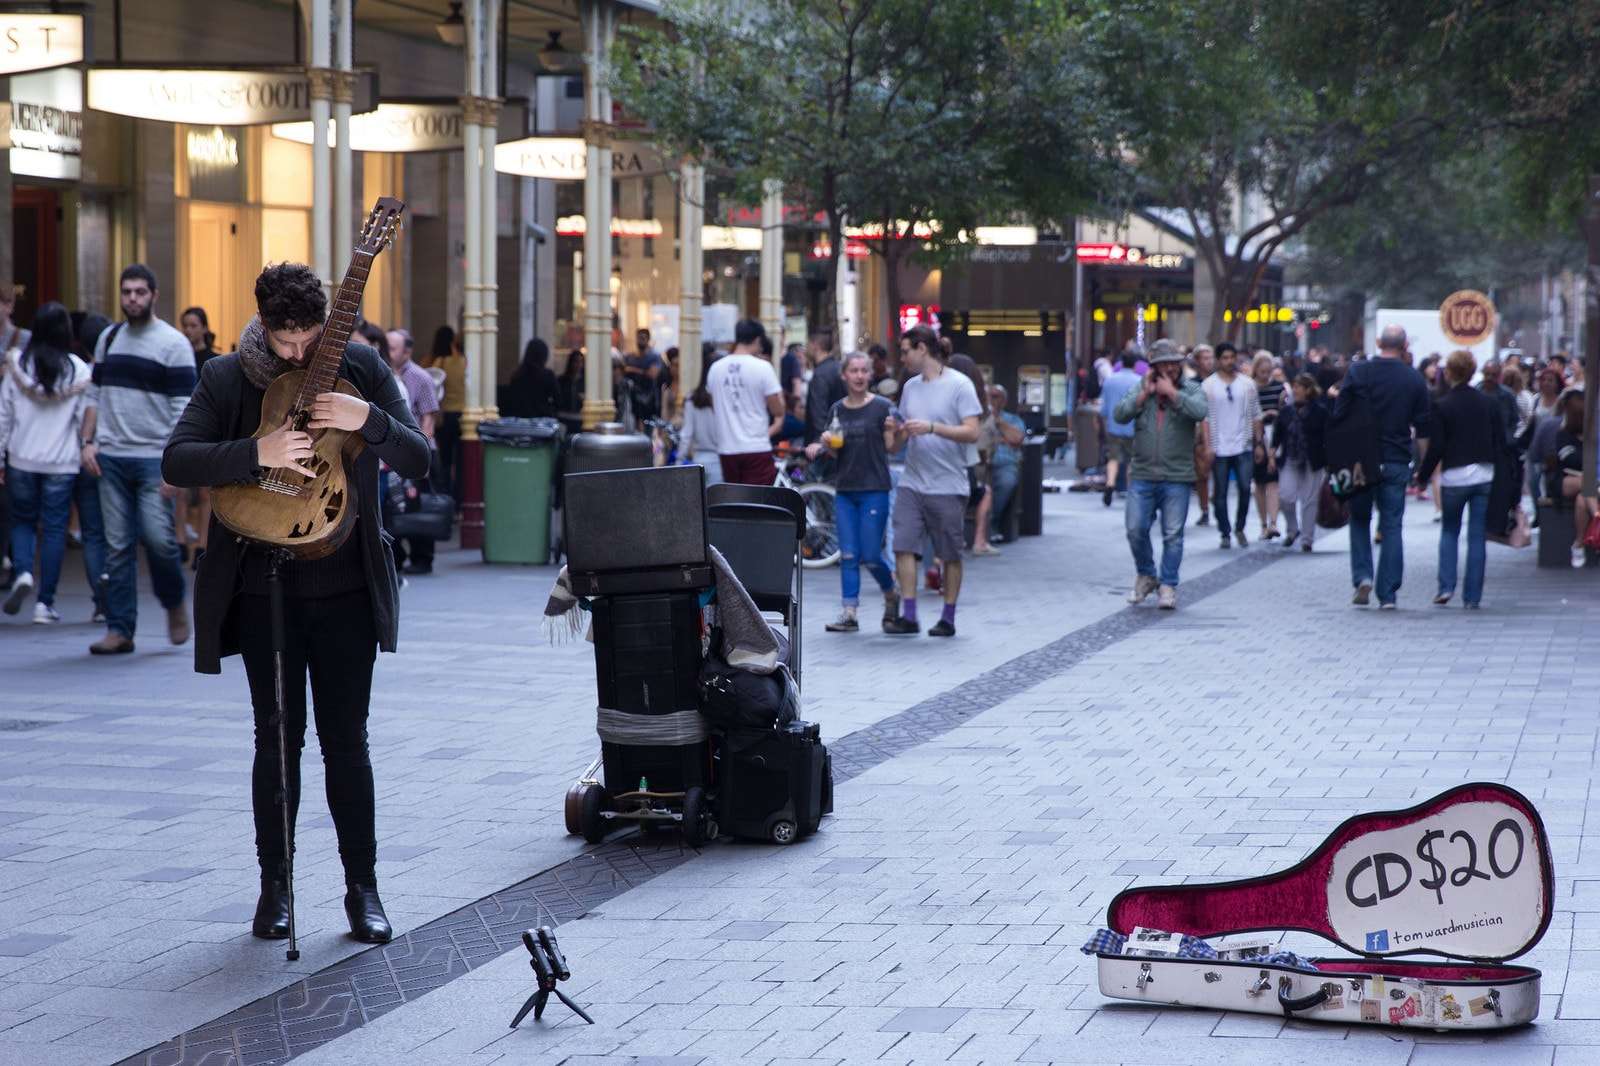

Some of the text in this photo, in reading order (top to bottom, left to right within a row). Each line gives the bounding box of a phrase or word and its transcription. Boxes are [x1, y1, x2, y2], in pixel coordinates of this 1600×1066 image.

[520, 152, 643, 172] PANDRA
[1450, 303, 1486, 332] UGG
[1345, 818, 1524, 908] CD $20
[1393, 911, 1504, 944] tomwardmusician
